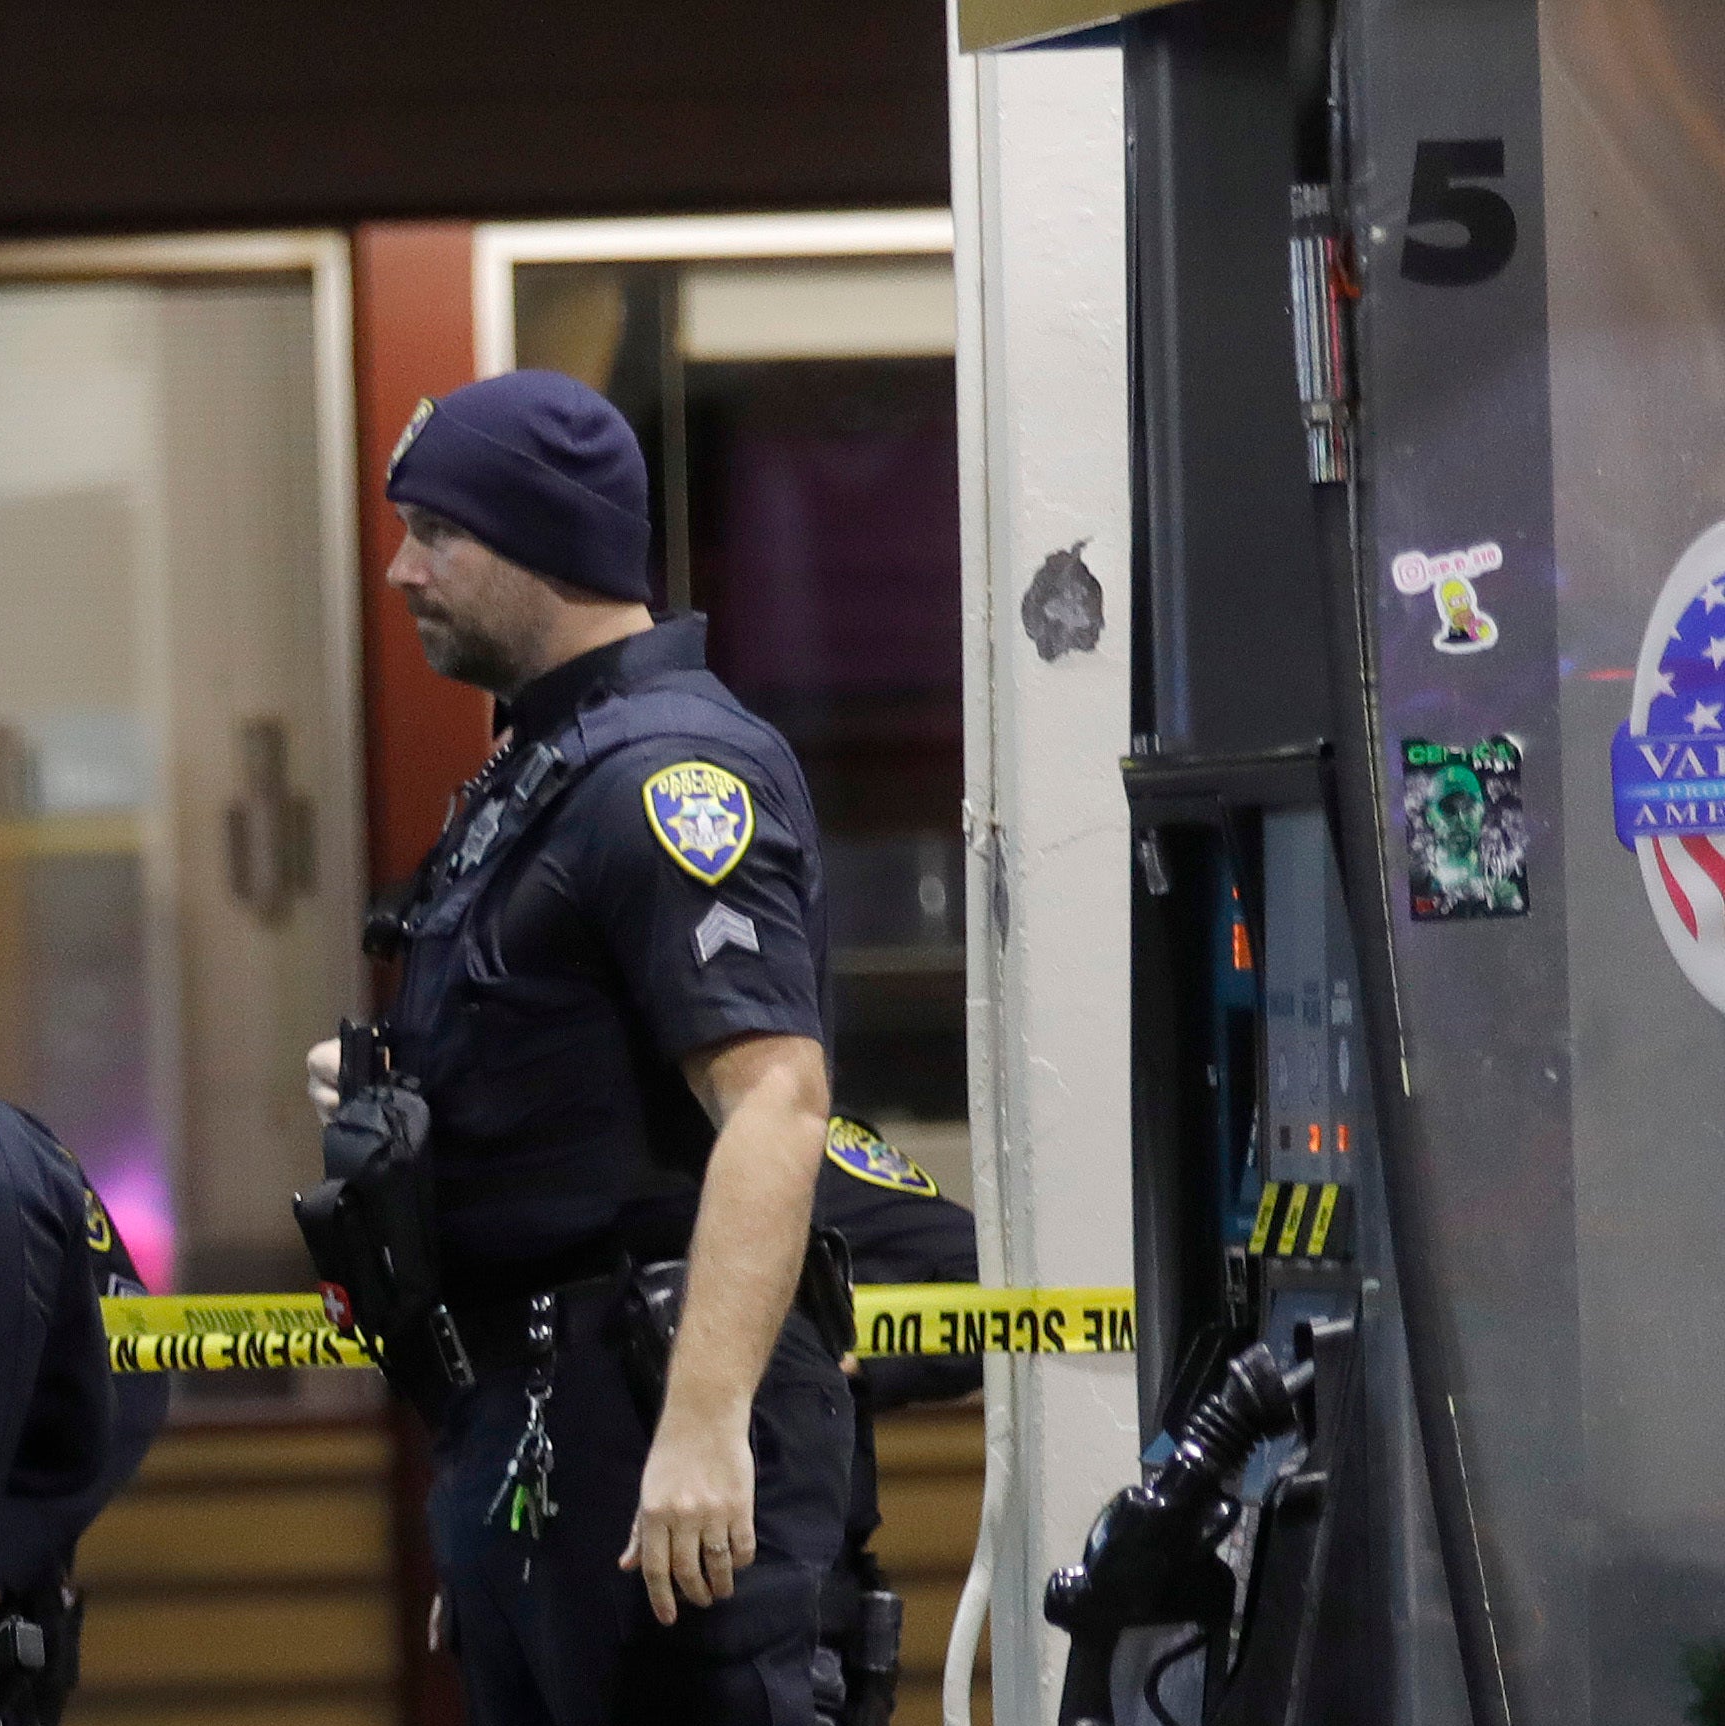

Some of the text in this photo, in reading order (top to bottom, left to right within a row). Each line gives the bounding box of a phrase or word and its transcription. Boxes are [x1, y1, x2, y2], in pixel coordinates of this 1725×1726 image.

[1399, 137, 1517, 287] 5
[872, 1311, 922, 1354] DO
[940, 1308, 1067, 1354] SCENE
